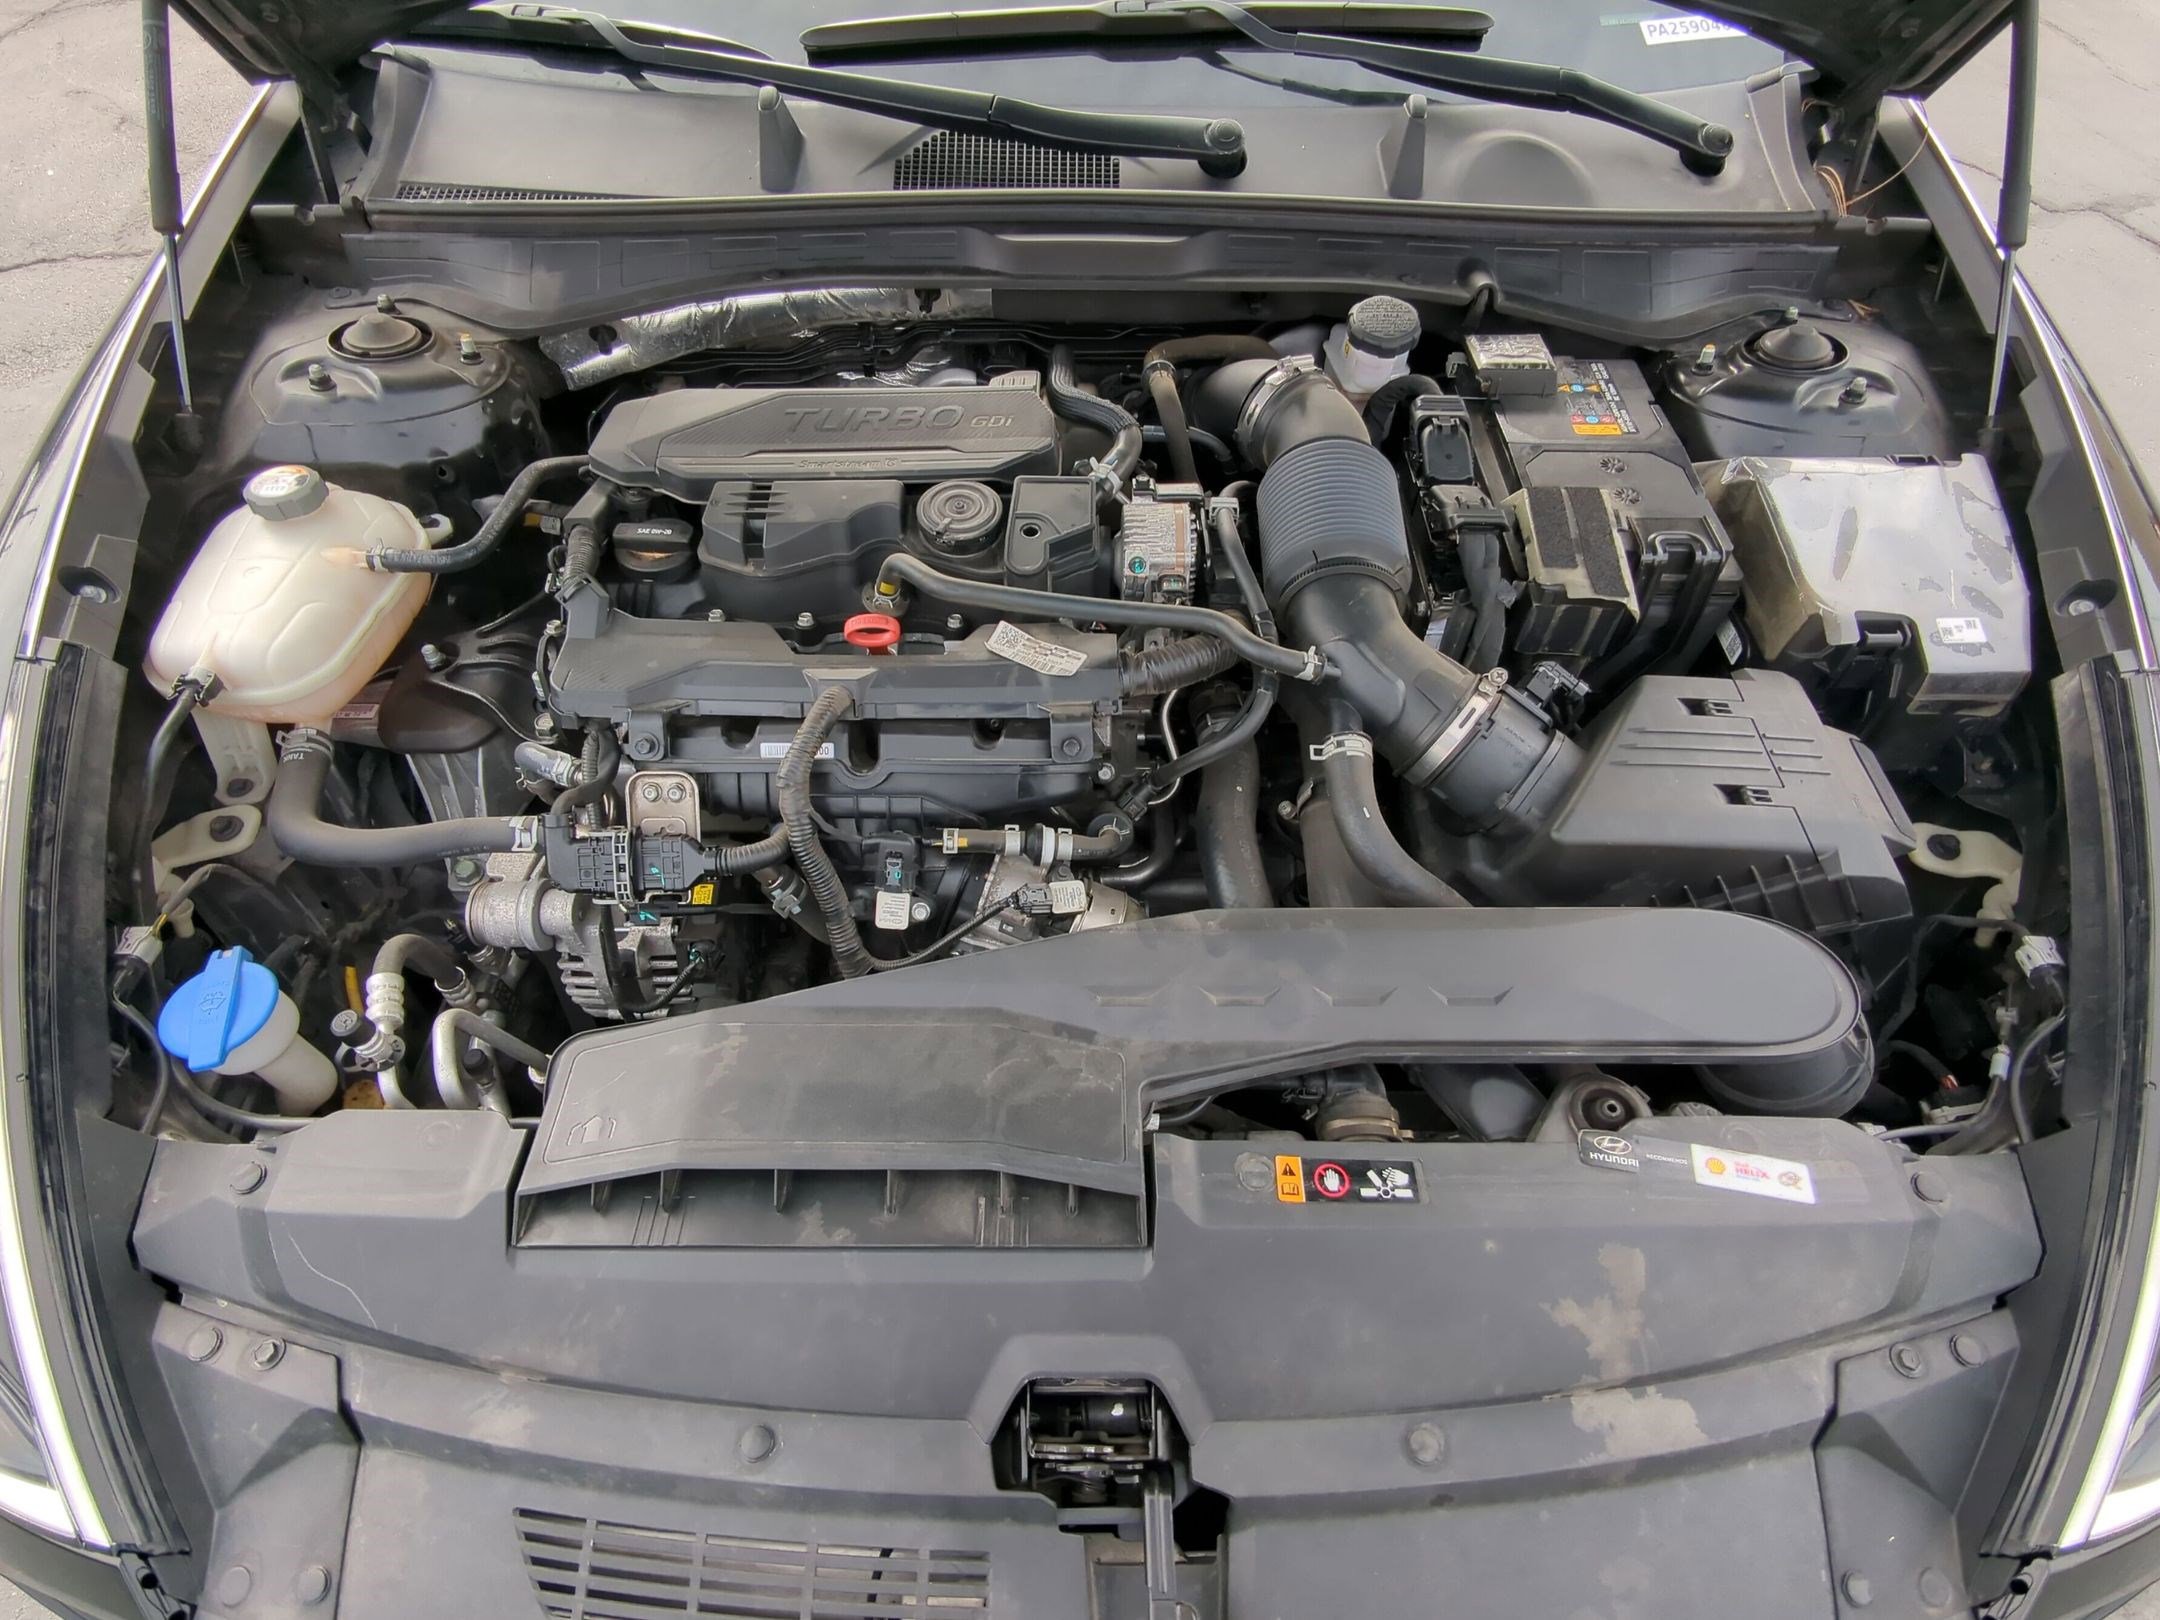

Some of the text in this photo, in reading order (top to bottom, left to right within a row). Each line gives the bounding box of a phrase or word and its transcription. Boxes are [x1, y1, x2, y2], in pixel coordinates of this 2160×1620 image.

[784, 404, 1014, 433] TURBO GDi
[636, 527, 672, 535] SAE 0W-20
[1589, 1151, 1640, 1168] HYUNDAI
[1734, 1167, 1770, 1179] HELIX
